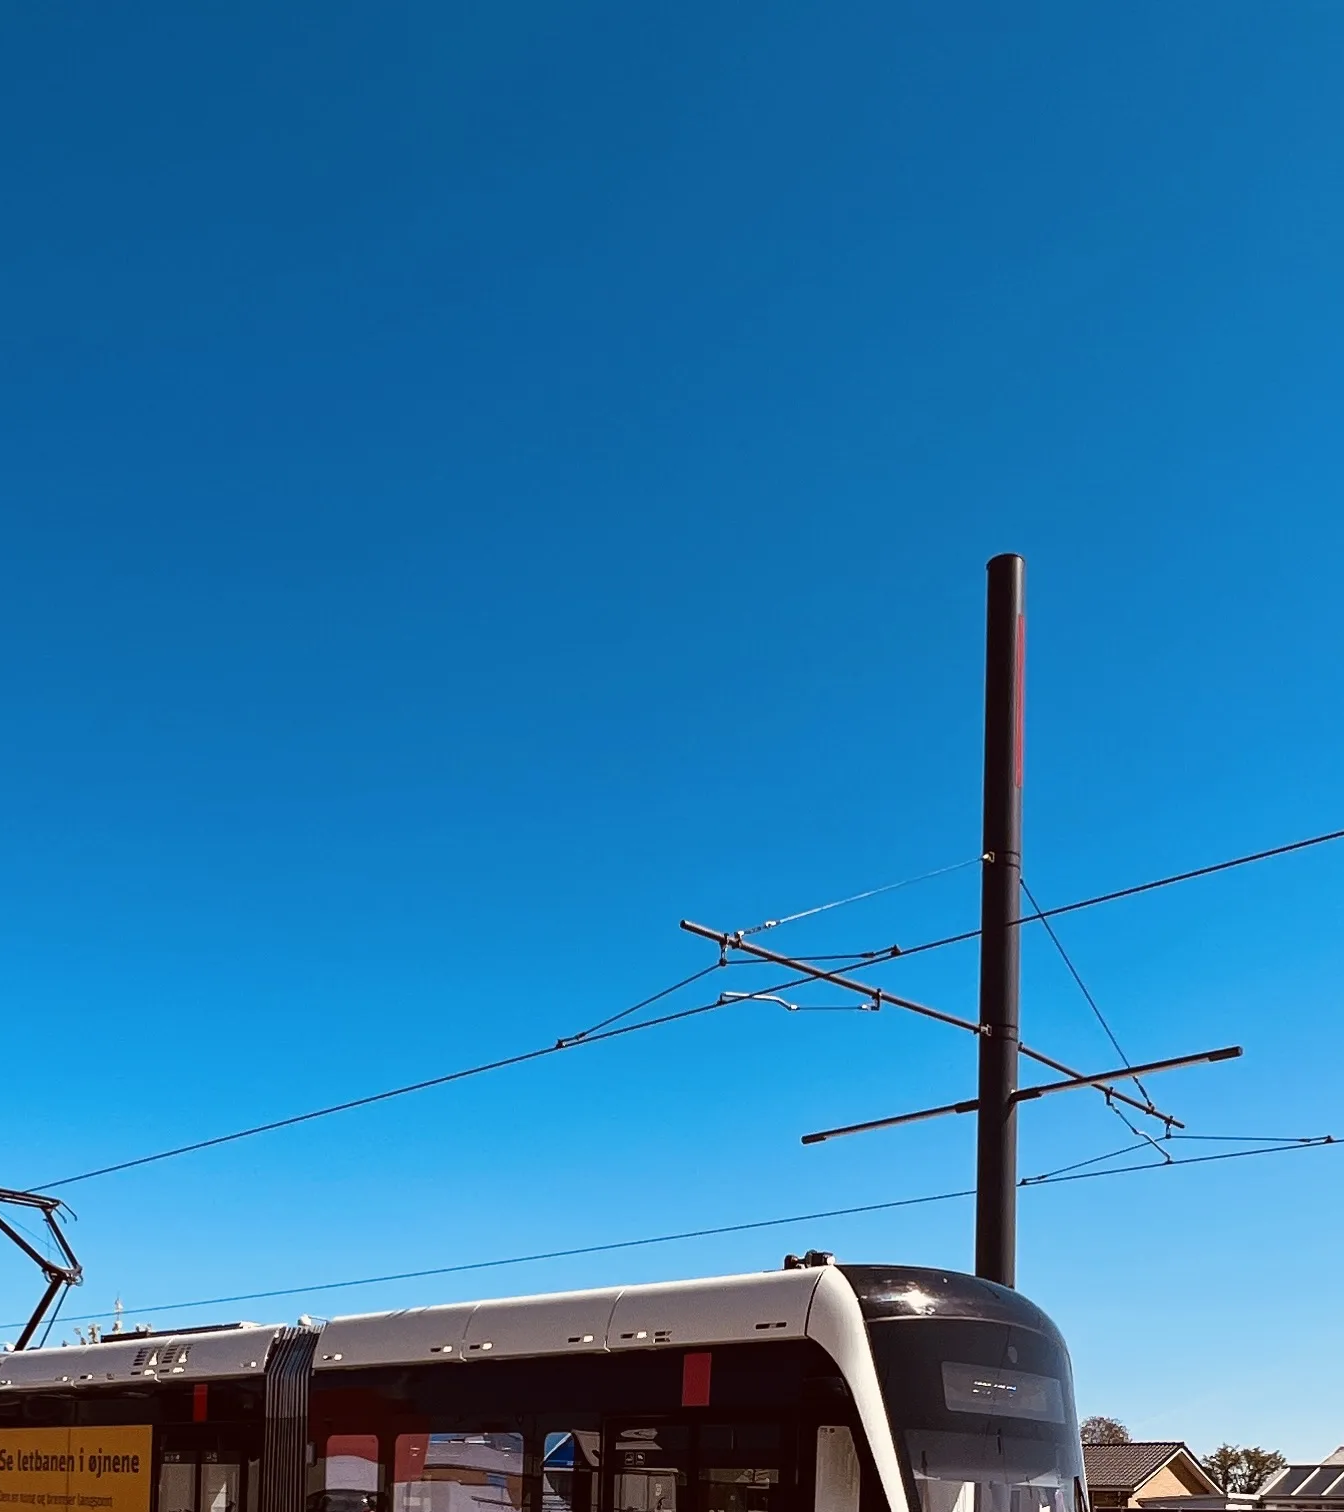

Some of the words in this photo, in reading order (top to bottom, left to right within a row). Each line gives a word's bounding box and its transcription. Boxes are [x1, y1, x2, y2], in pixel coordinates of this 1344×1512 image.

[17, 1449, 75, 1472] letbanen
[79, 1447, 84, 1472] i
[88, 1448, 140, 1478] øjnene
